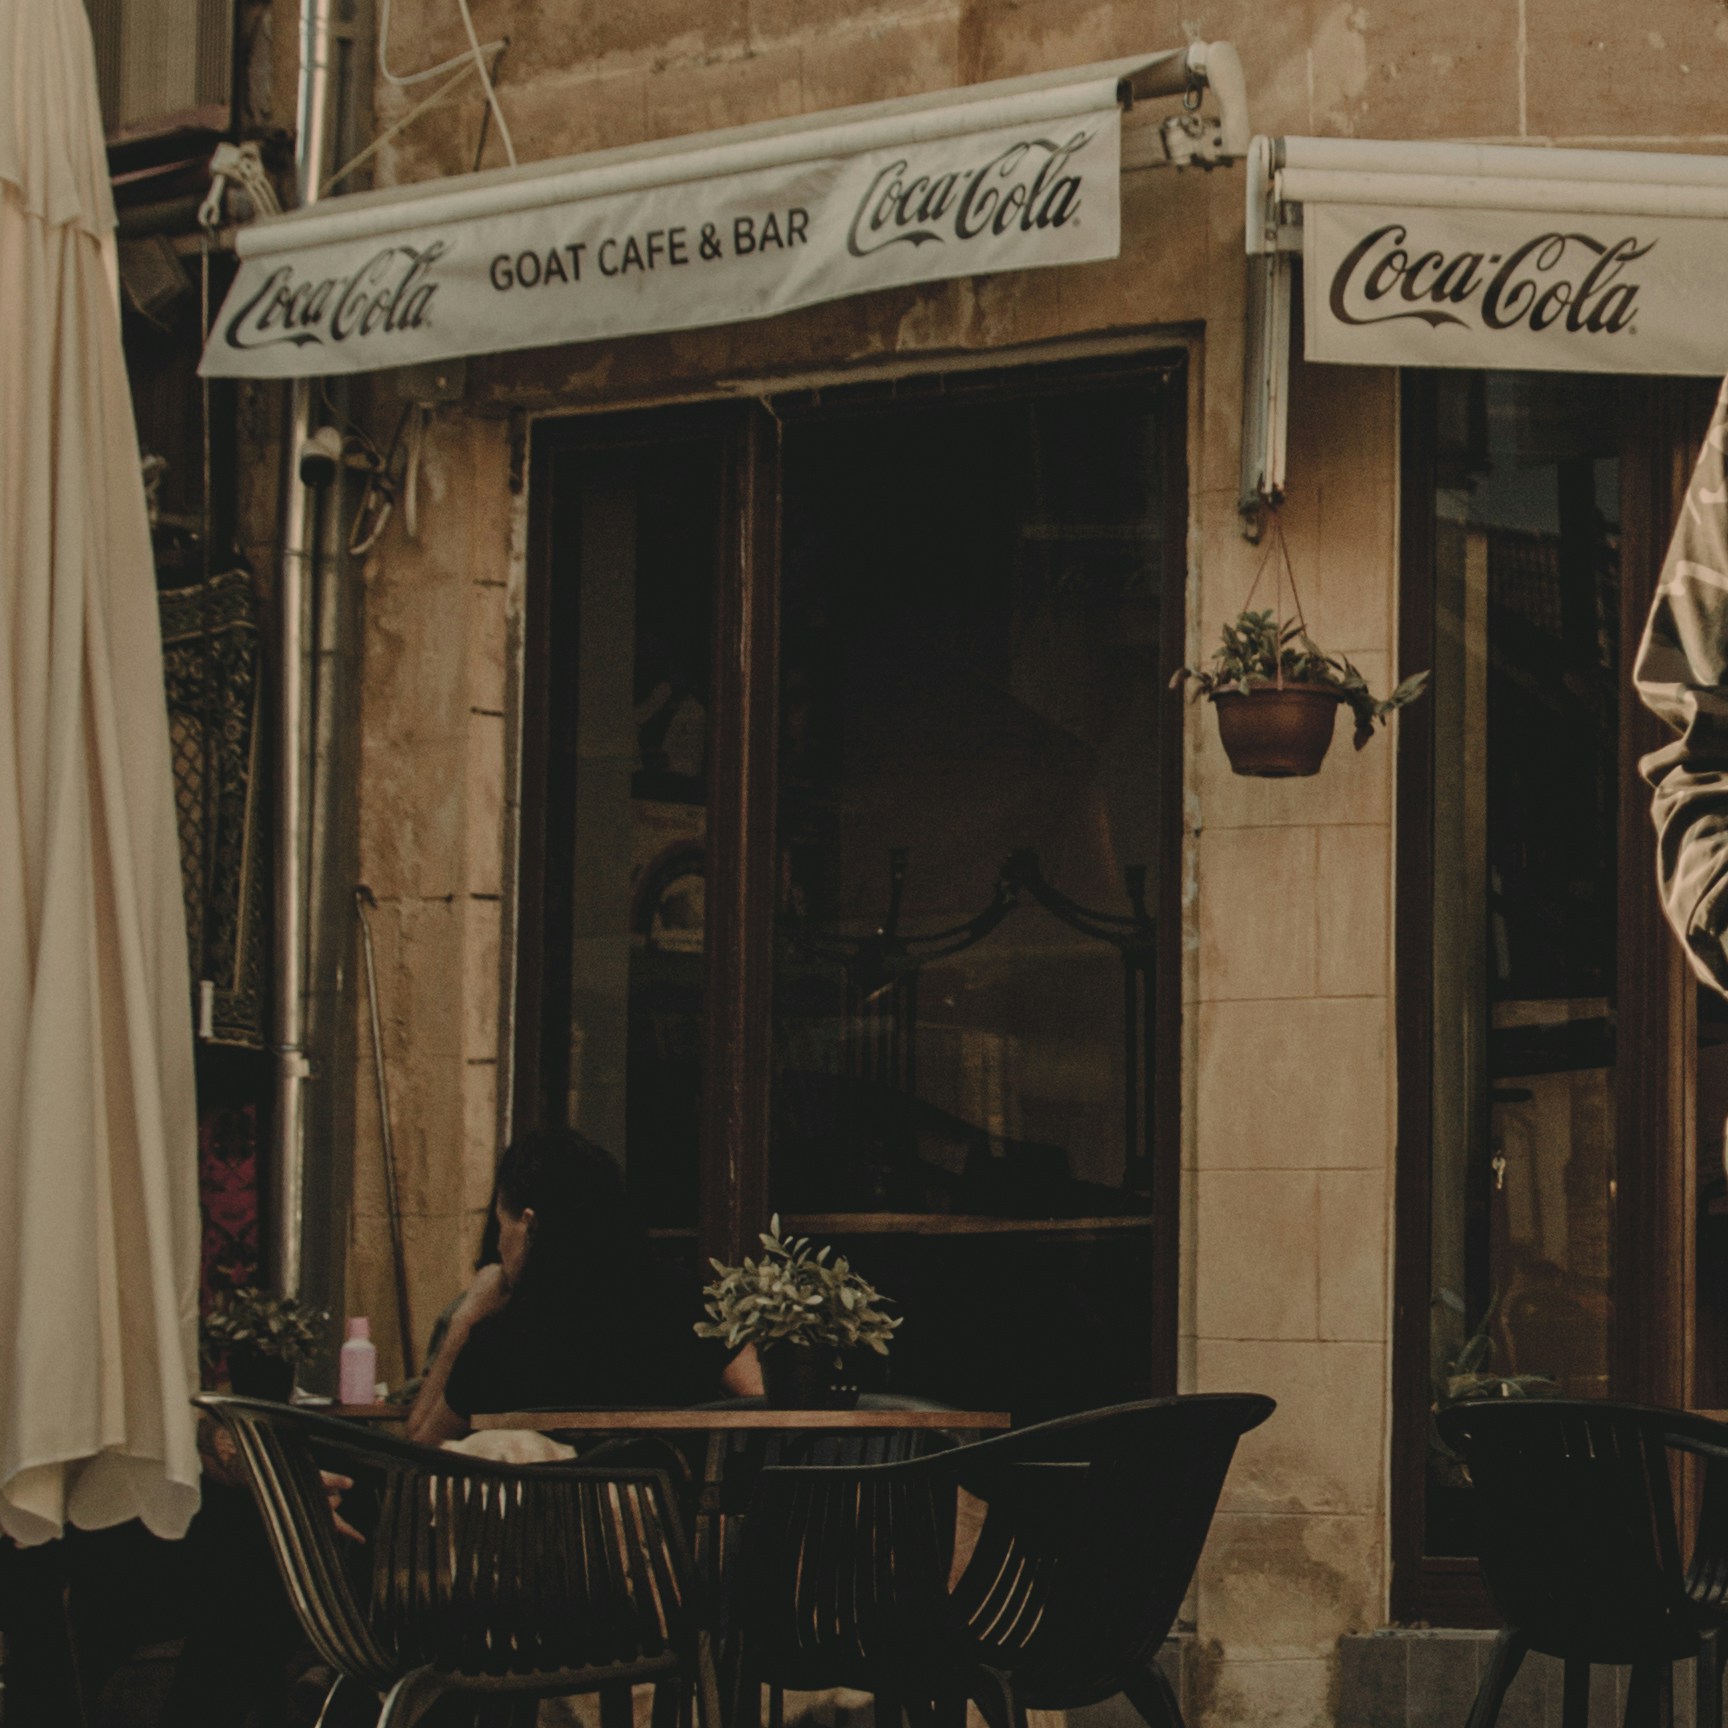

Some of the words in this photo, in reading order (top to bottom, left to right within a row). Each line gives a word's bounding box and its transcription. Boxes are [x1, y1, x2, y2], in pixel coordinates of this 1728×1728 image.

[490, 243, 586, 291] GOAT
[598, 227, 688, 276] CAFE
[699, 222, 722, 261] &
[733, 207, 809, 255] BAR
[848, 131, 1098, 257] Coca-Cola
[224, 239, 448, 350] Coca-Cola
[1329, 223, 1660, 335] Coca-Cola
